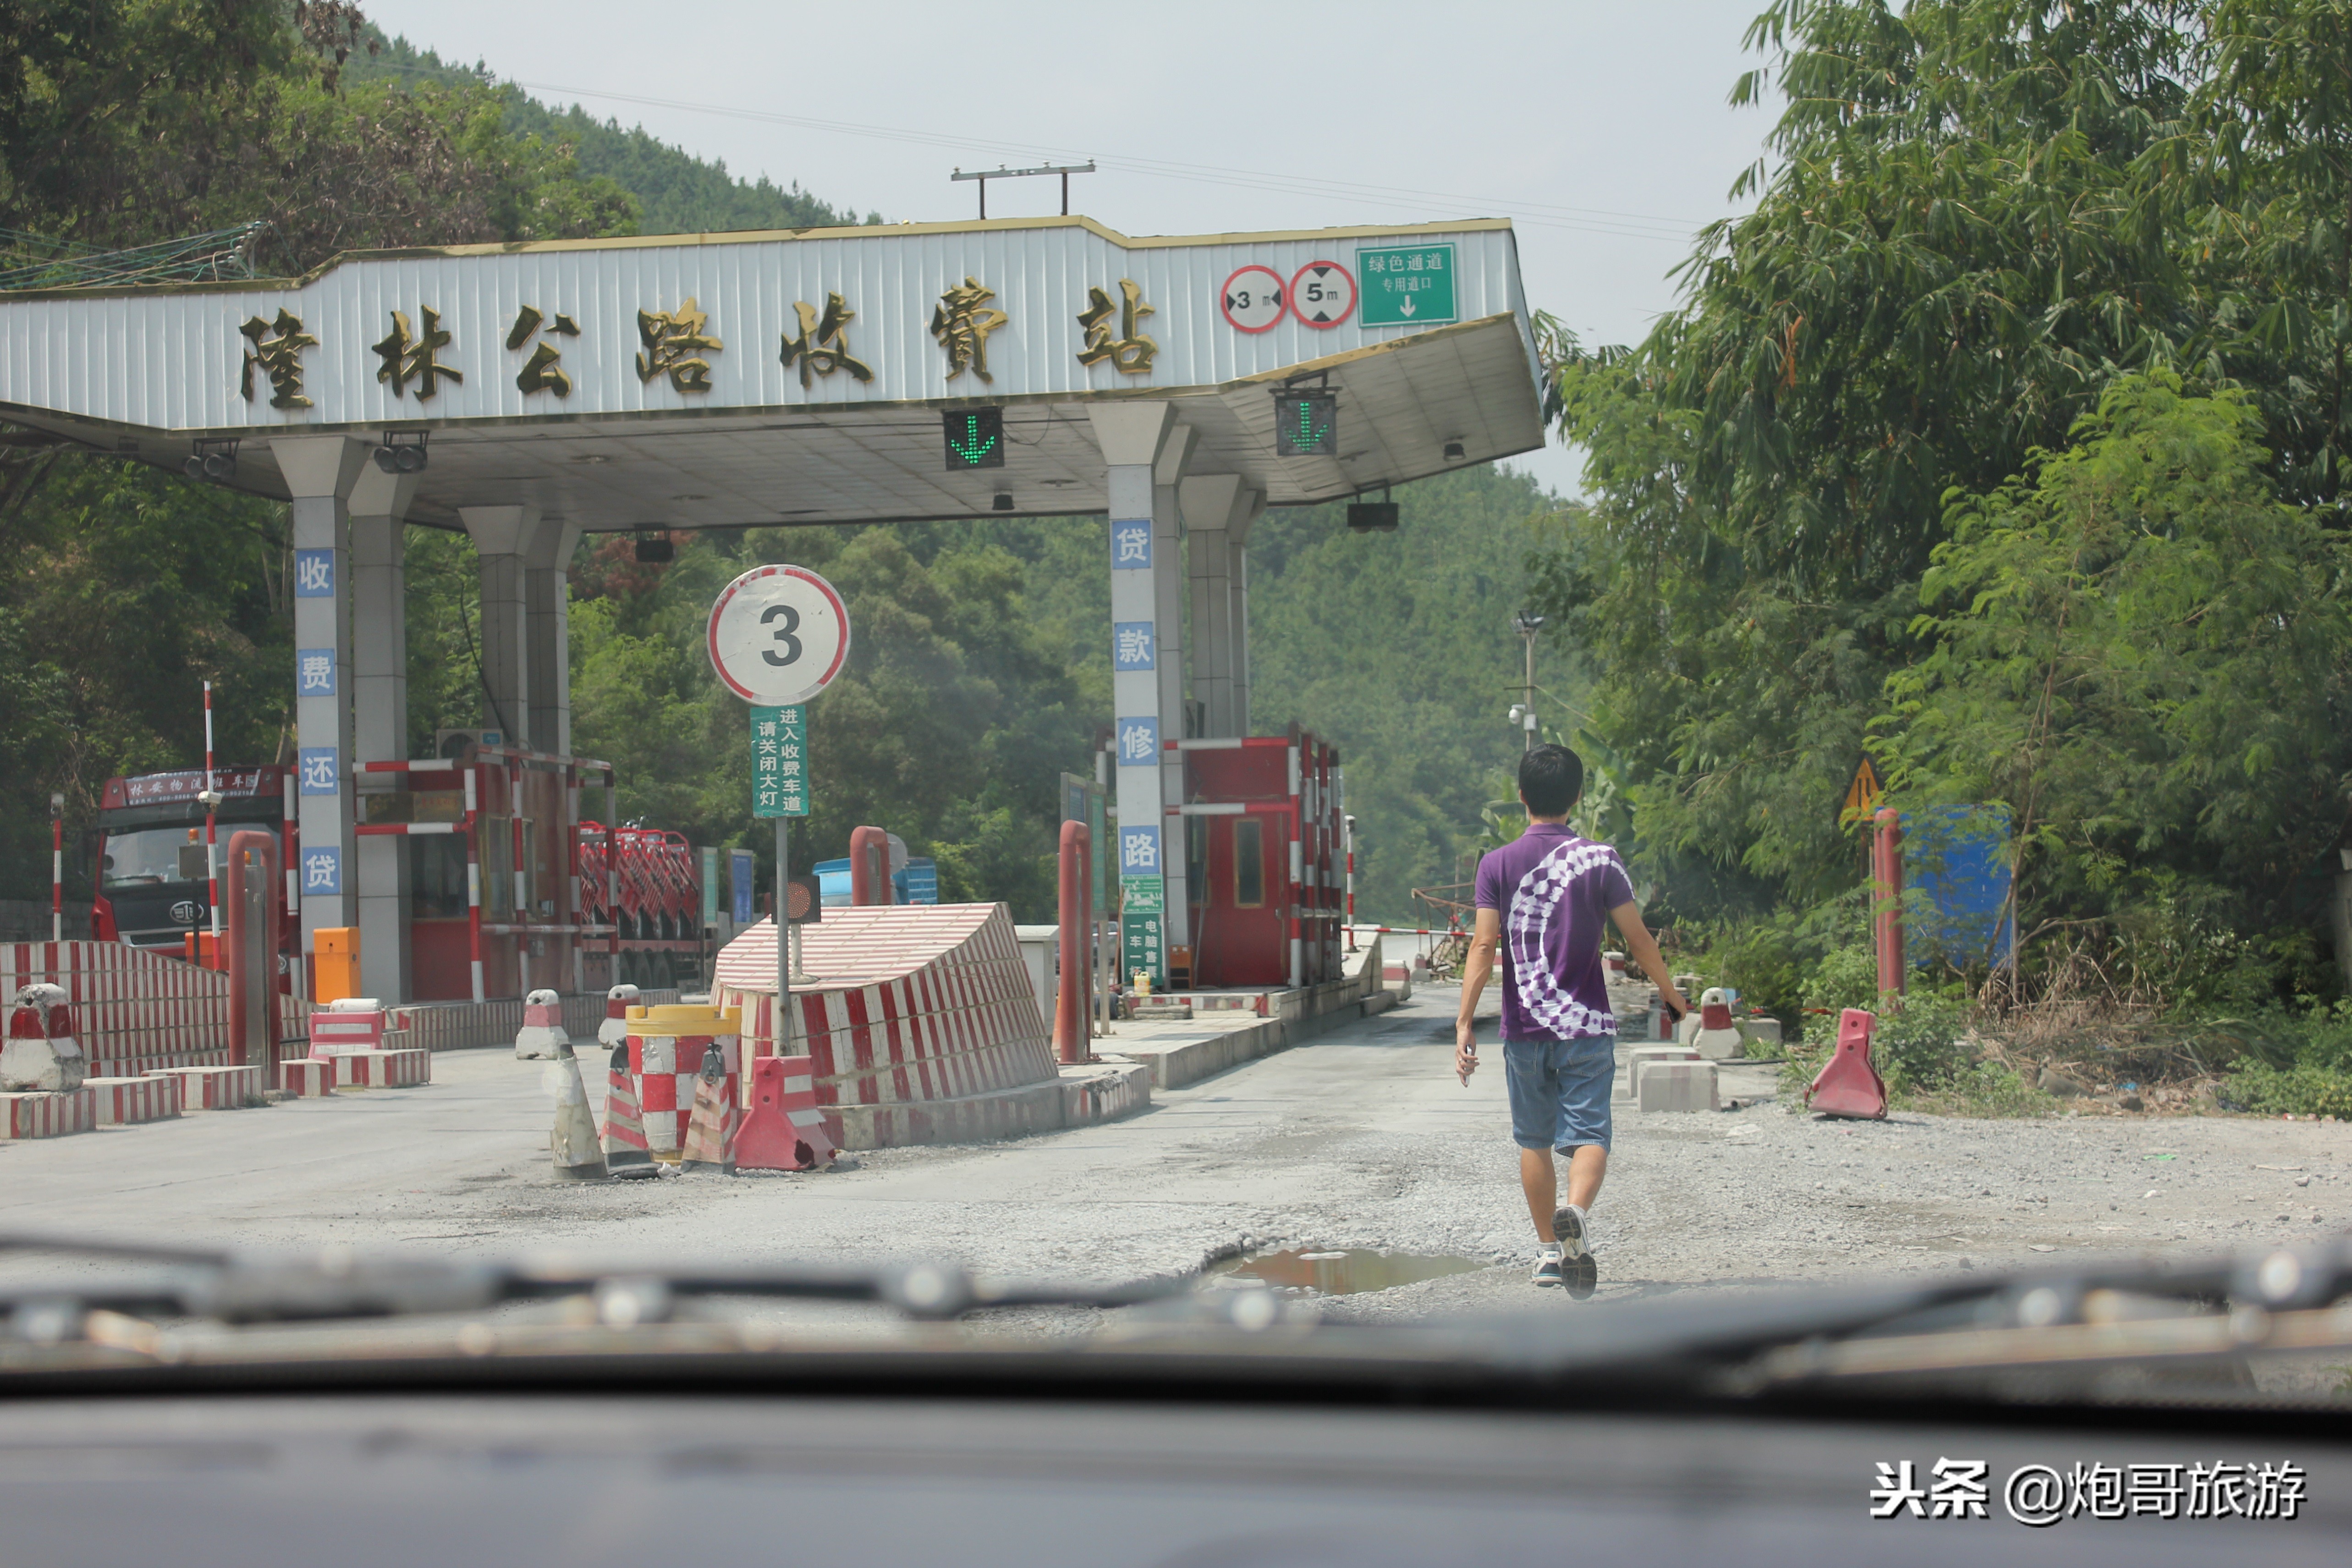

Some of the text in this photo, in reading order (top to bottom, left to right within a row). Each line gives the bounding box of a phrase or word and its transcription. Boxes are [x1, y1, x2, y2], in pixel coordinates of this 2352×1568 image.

[1368, 253, 1443, 273] 绿色通道
[1381, 277, 1432, 293] 专用道口
[760, 605, 802, 666] 3
[758, 721, 778, 806] 请关闭大灯
[780, 709, 801, 811] 进入收费车道
[1145, 920, 1157, 978] 电脑售票
